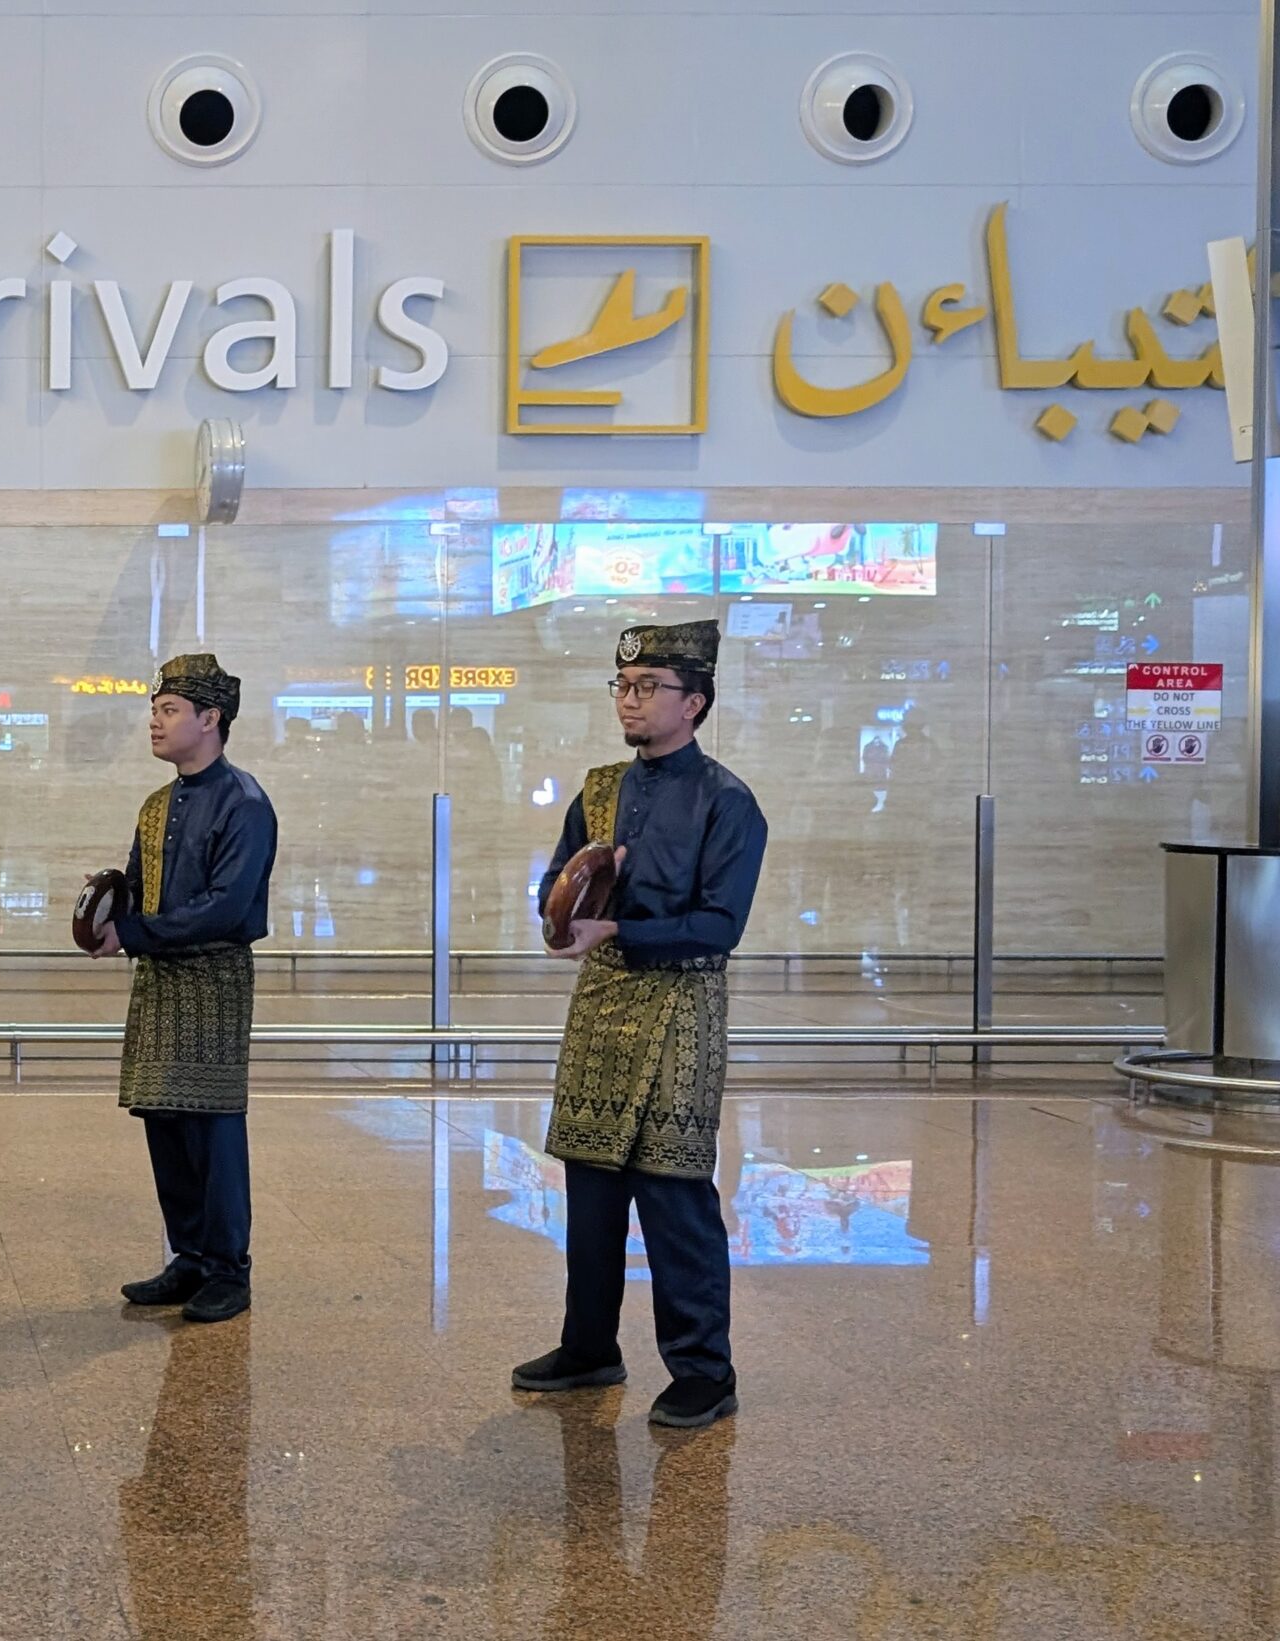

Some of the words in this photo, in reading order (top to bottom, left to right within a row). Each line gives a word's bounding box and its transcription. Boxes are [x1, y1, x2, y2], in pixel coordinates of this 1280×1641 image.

[1142, 665, 1208, 676] CONTROL
[1156, 678, 1194, 688] AREA
[1153, 692, 1169, 702] DO
[1173, 692, 1195, 702] NOT
[1156, 706, 1191, 716] CROSS
[1127, 720, 1148, 730] THE
[1151, 720, 1194, 730] YELLOW
[1197, 720, 1220, 730] LINE
